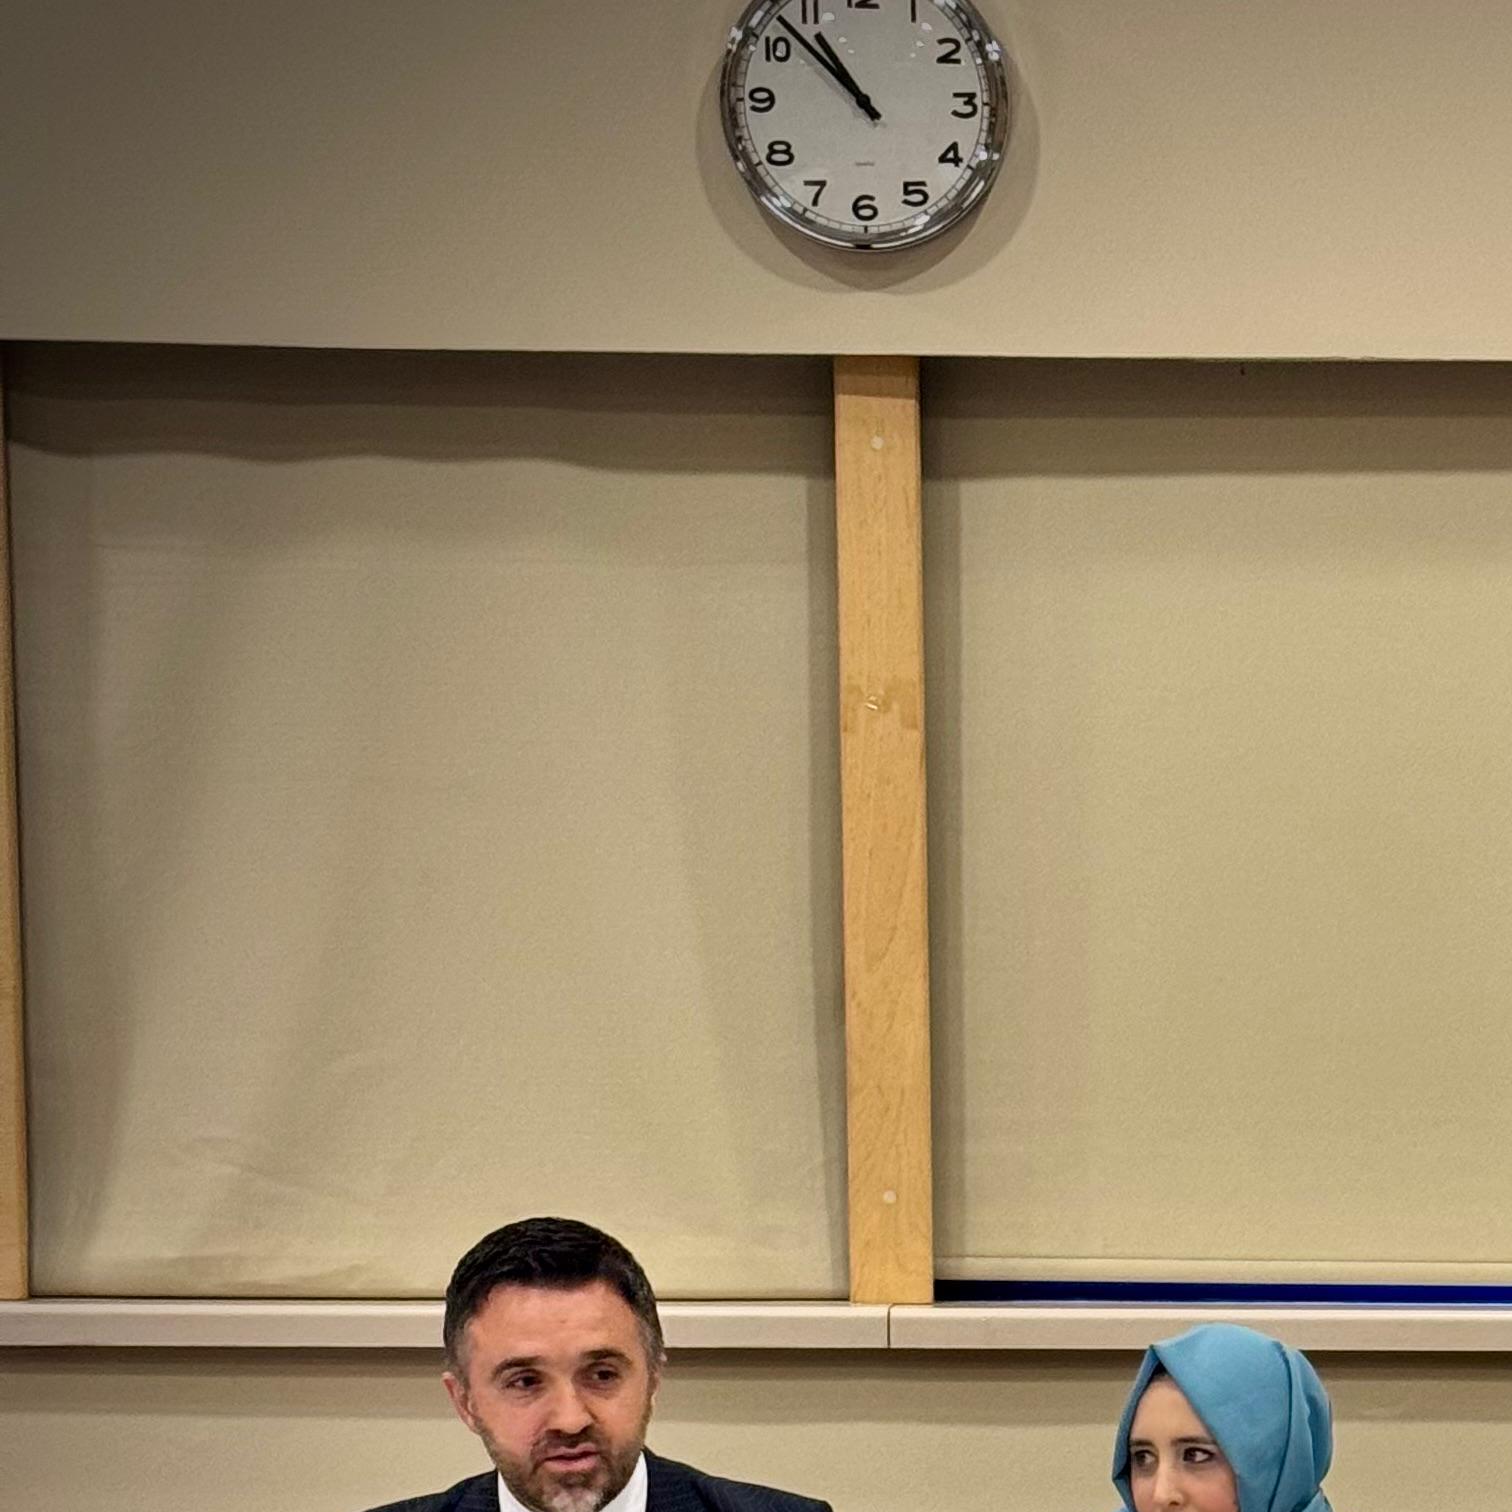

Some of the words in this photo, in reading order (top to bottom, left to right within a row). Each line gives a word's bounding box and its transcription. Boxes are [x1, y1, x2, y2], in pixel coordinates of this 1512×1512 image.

[801, 0, 819, 24] 11
[910, 0, 916, 23] 1
[765, 36, 792, 63] 10
[936, 38, 962, 64] 2
[748, 87, 775, 113] 9
[951, 92, 978, 119] 3
[766, 141, 795, 166] 8
[938, 142, 963, 167] 4
[803, 180, 827, 206] 7
[902, 181, 929, 207] 5
[852, 195, 878, 221] 6
